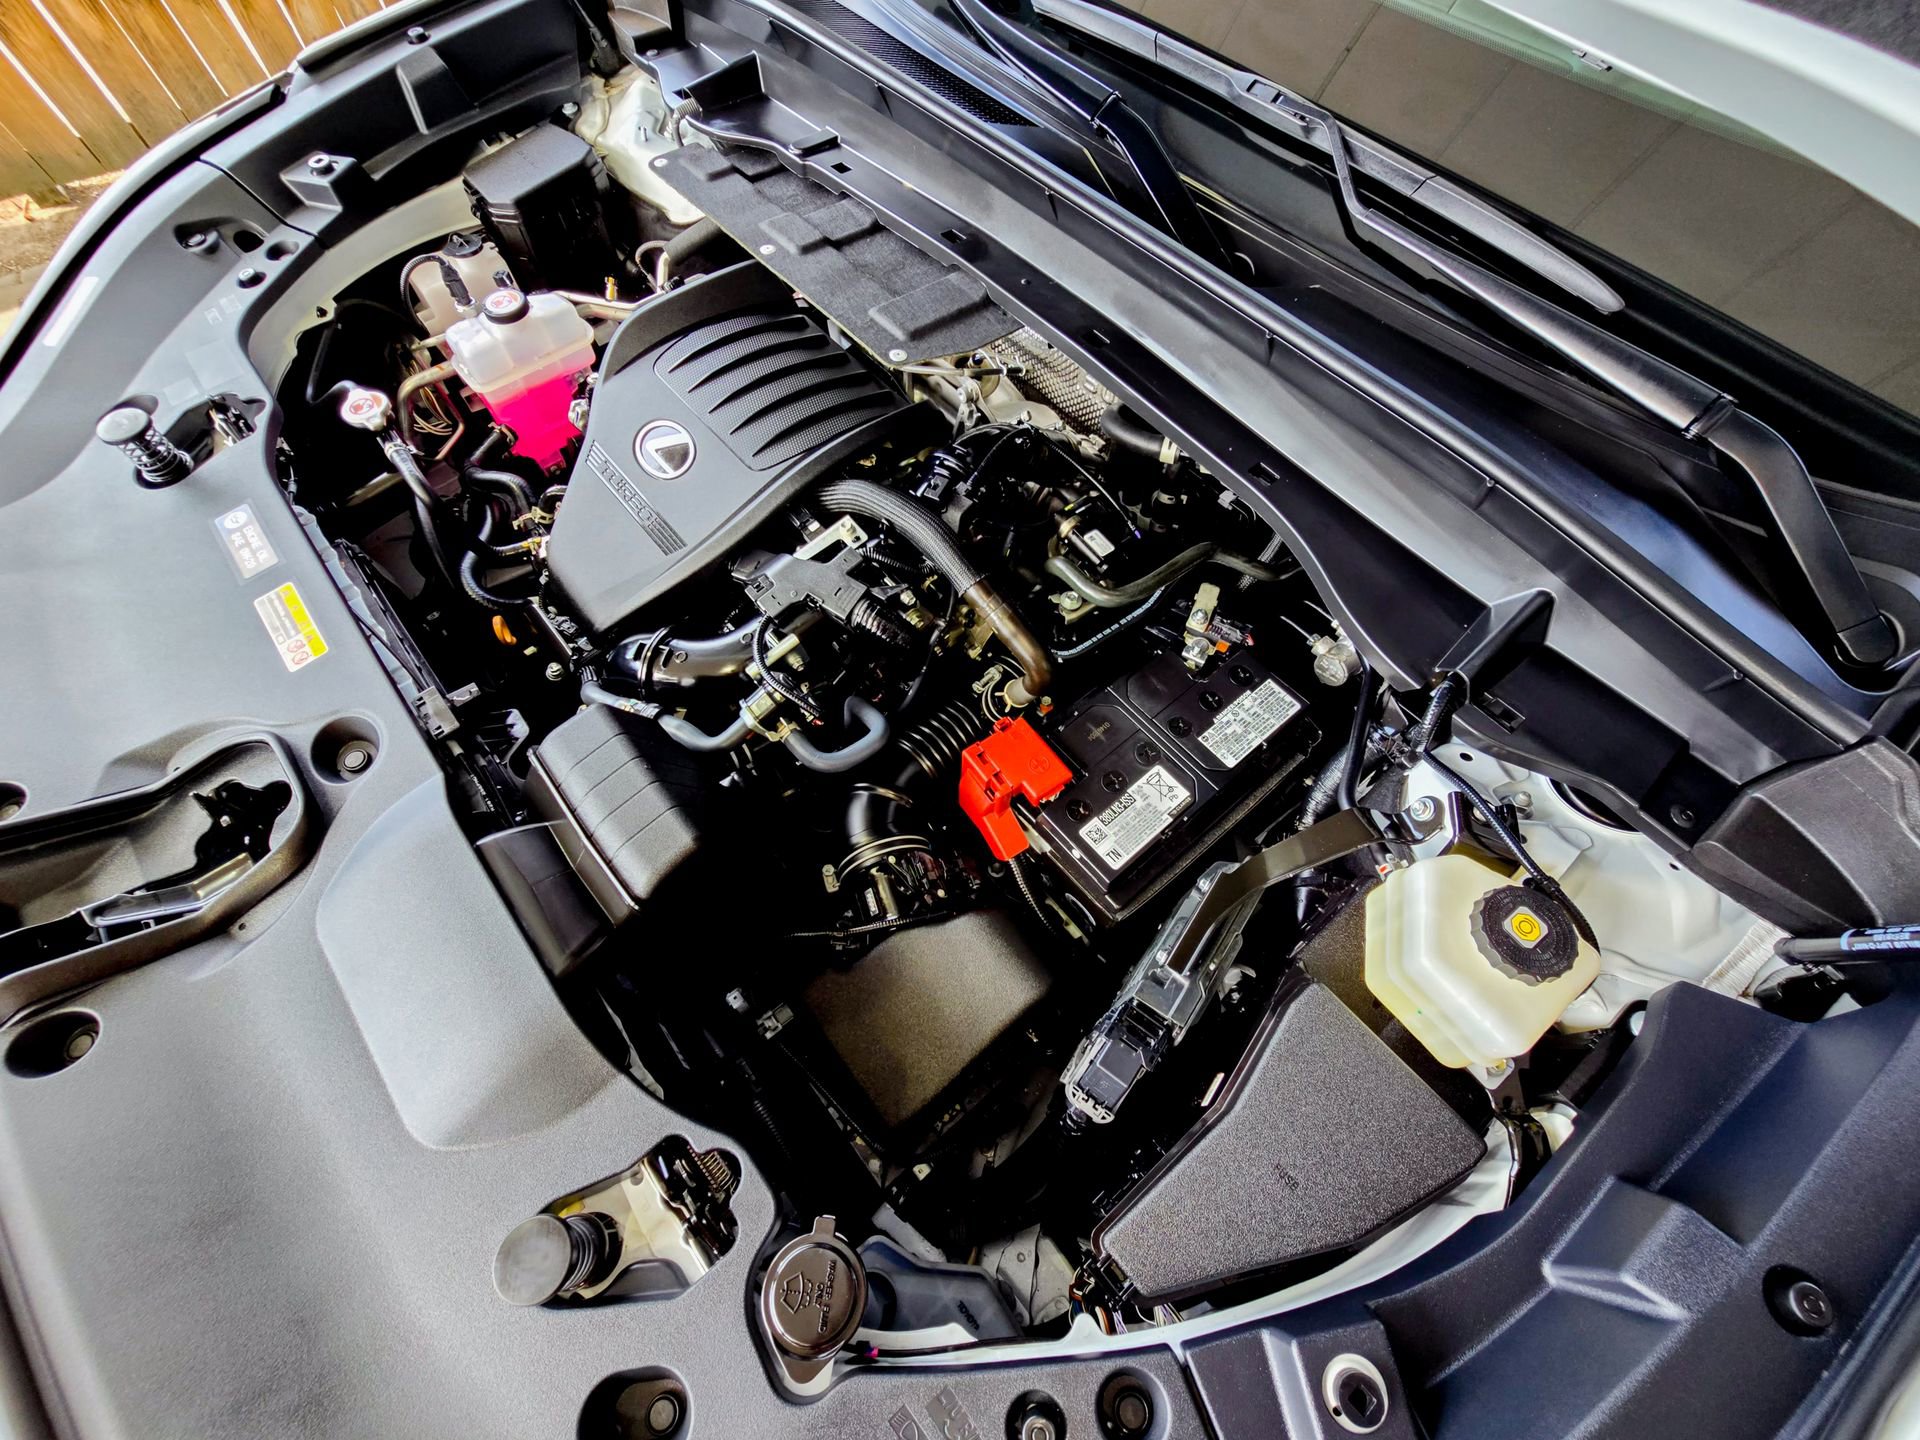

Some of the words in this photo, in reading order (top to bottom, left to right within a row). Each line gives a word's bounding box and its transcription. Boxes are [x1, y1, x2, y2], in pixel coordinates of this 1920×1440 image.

[599, 459, 654, 523] TURBO
[1099, 793, 1135, 825] 380LN3-ISS
[1168, 792, 1179, 802] Pb
[1105, 848, 1123, 864] TN
[823, 1259, 836, 1300] WASHER
[812, 1282, 824, 1308] ONLY
[817, 1305, 830, 1333] FLUID
